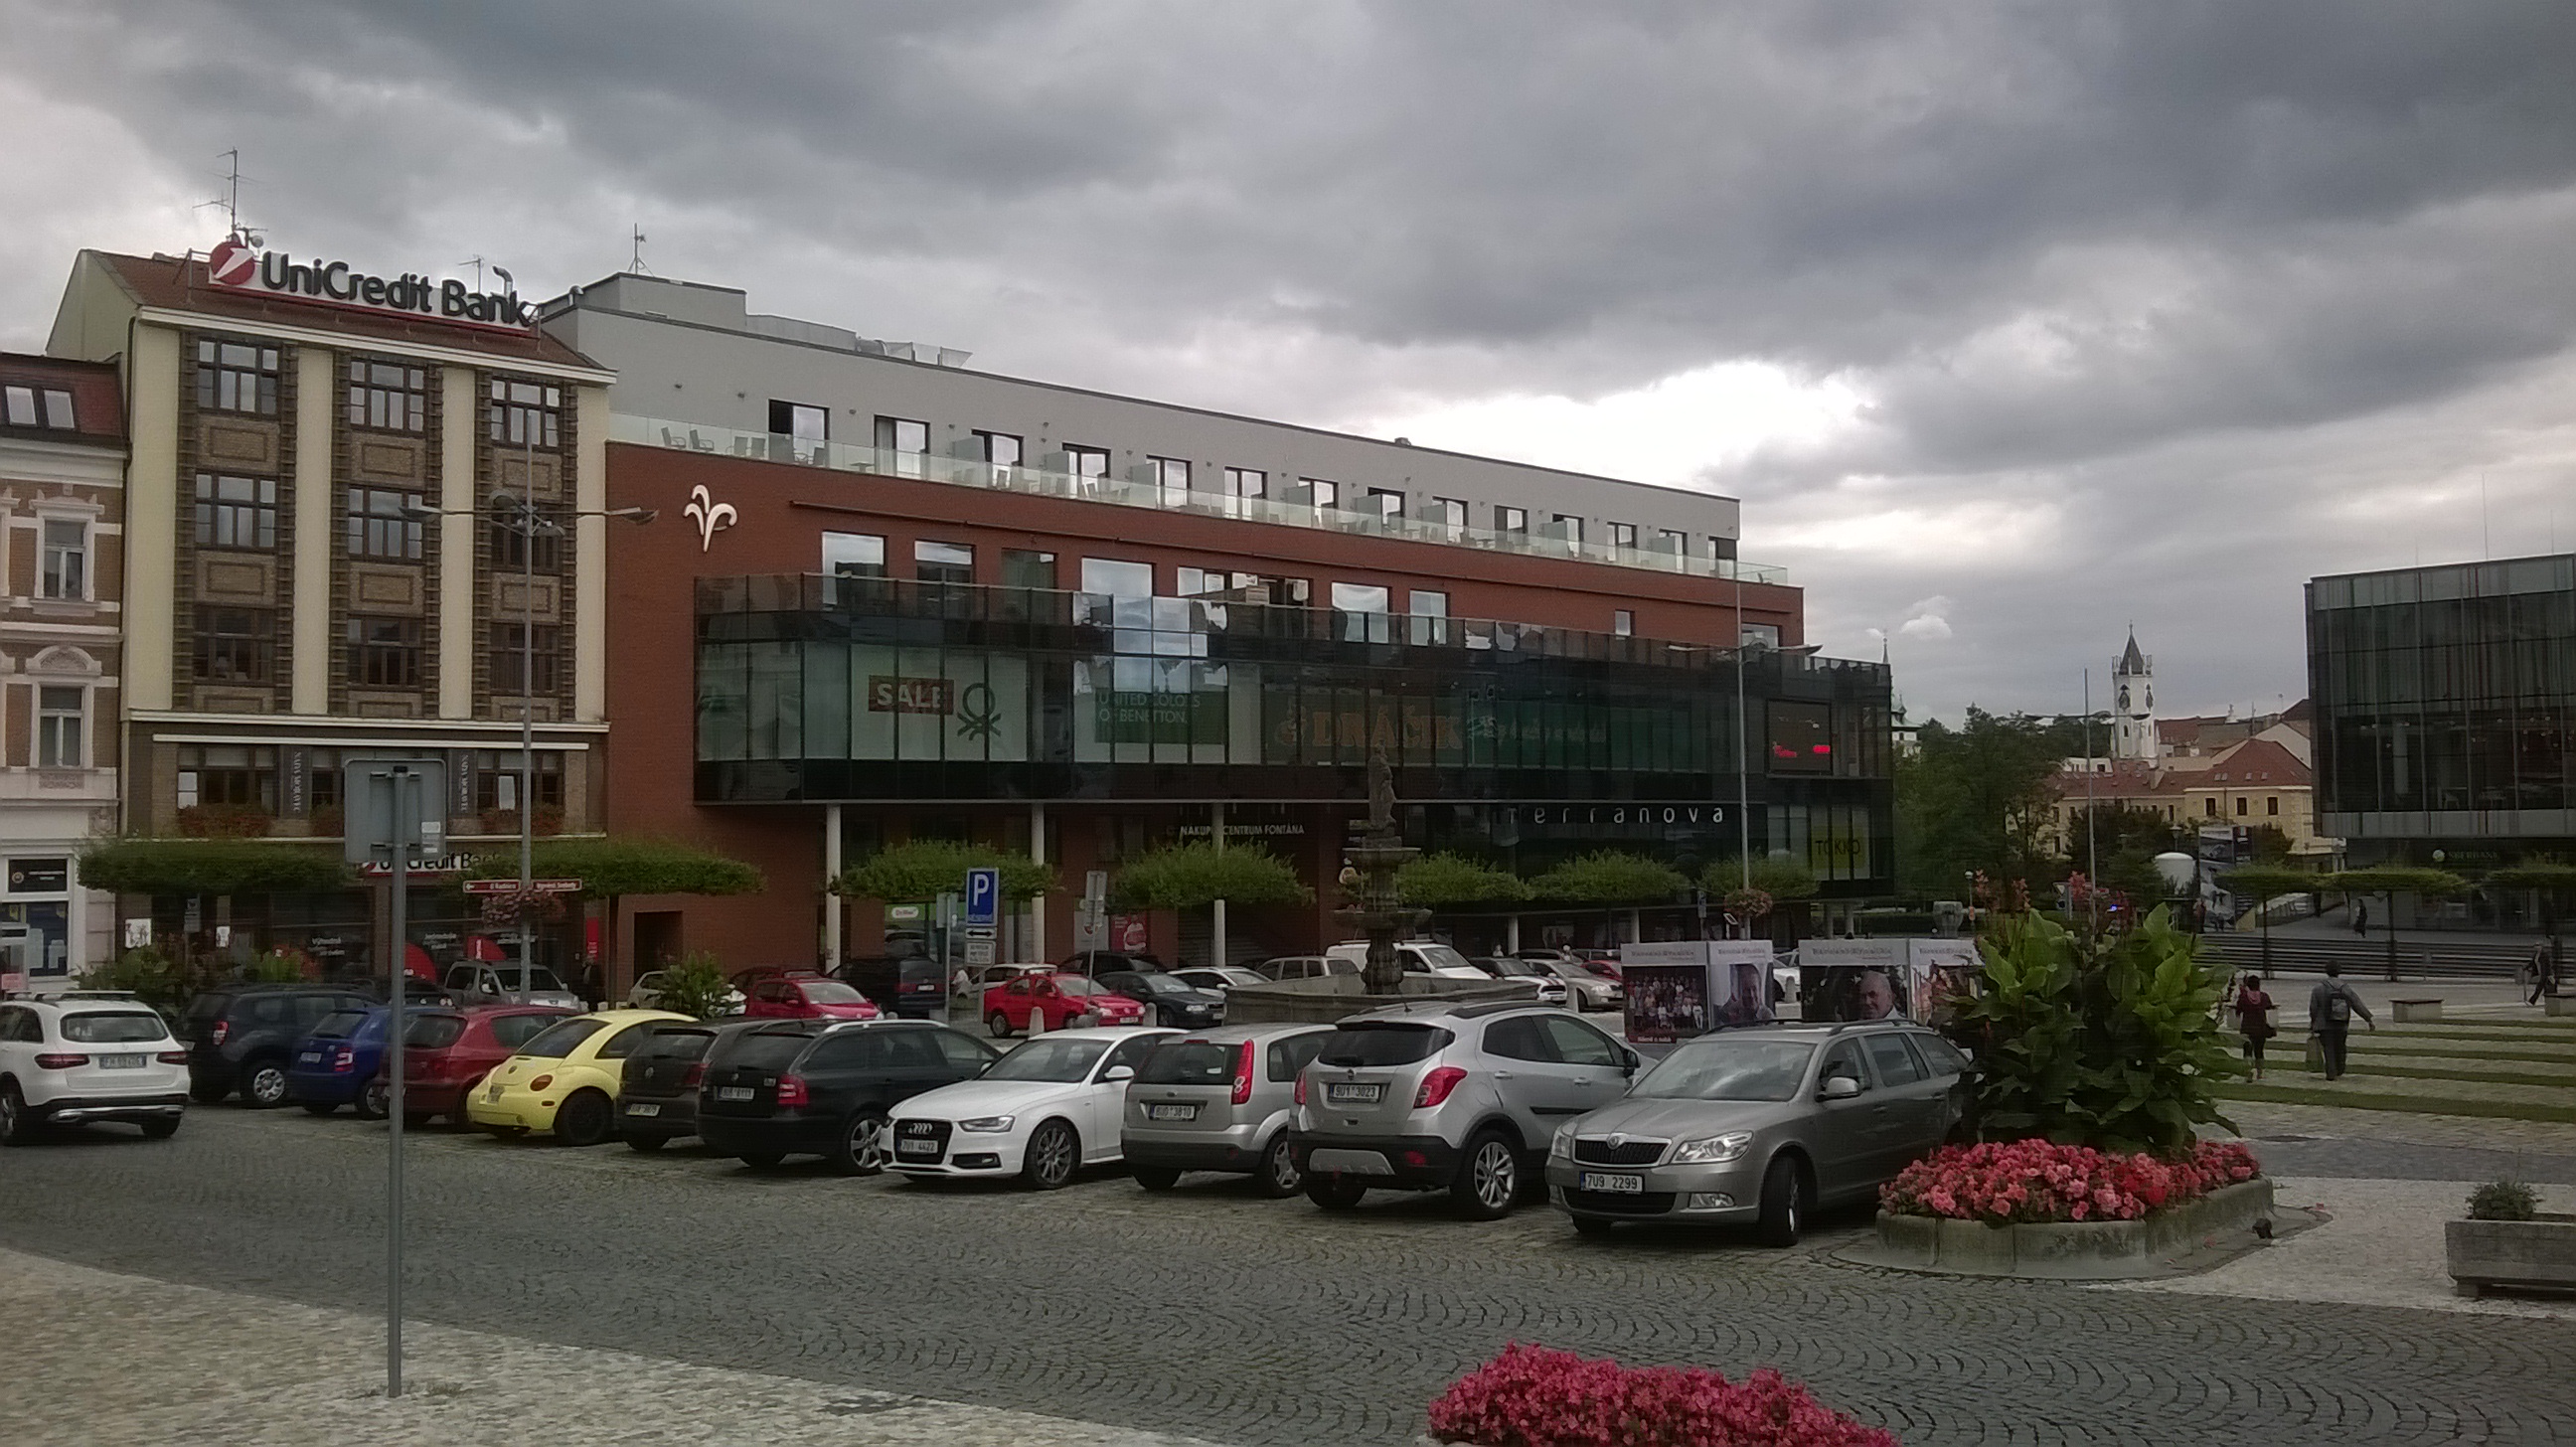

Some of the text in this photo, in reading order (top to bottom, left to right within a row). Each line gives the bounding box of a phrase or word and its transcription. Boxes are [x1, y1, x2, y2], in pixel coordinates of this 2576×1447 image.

[262, 250, 534, 327] UniCredit Bank
[877, 683, 943, 709] SALE
[1099, 693, 1148, 707] UNITED
[1222, 825, 1263, 836] CENTRUM
[1264, 823, 1305, 836] FONTÁNA
[973, 874, 989, 906] P
[1587, 1175, 1638, 1189] 7U9 2299
